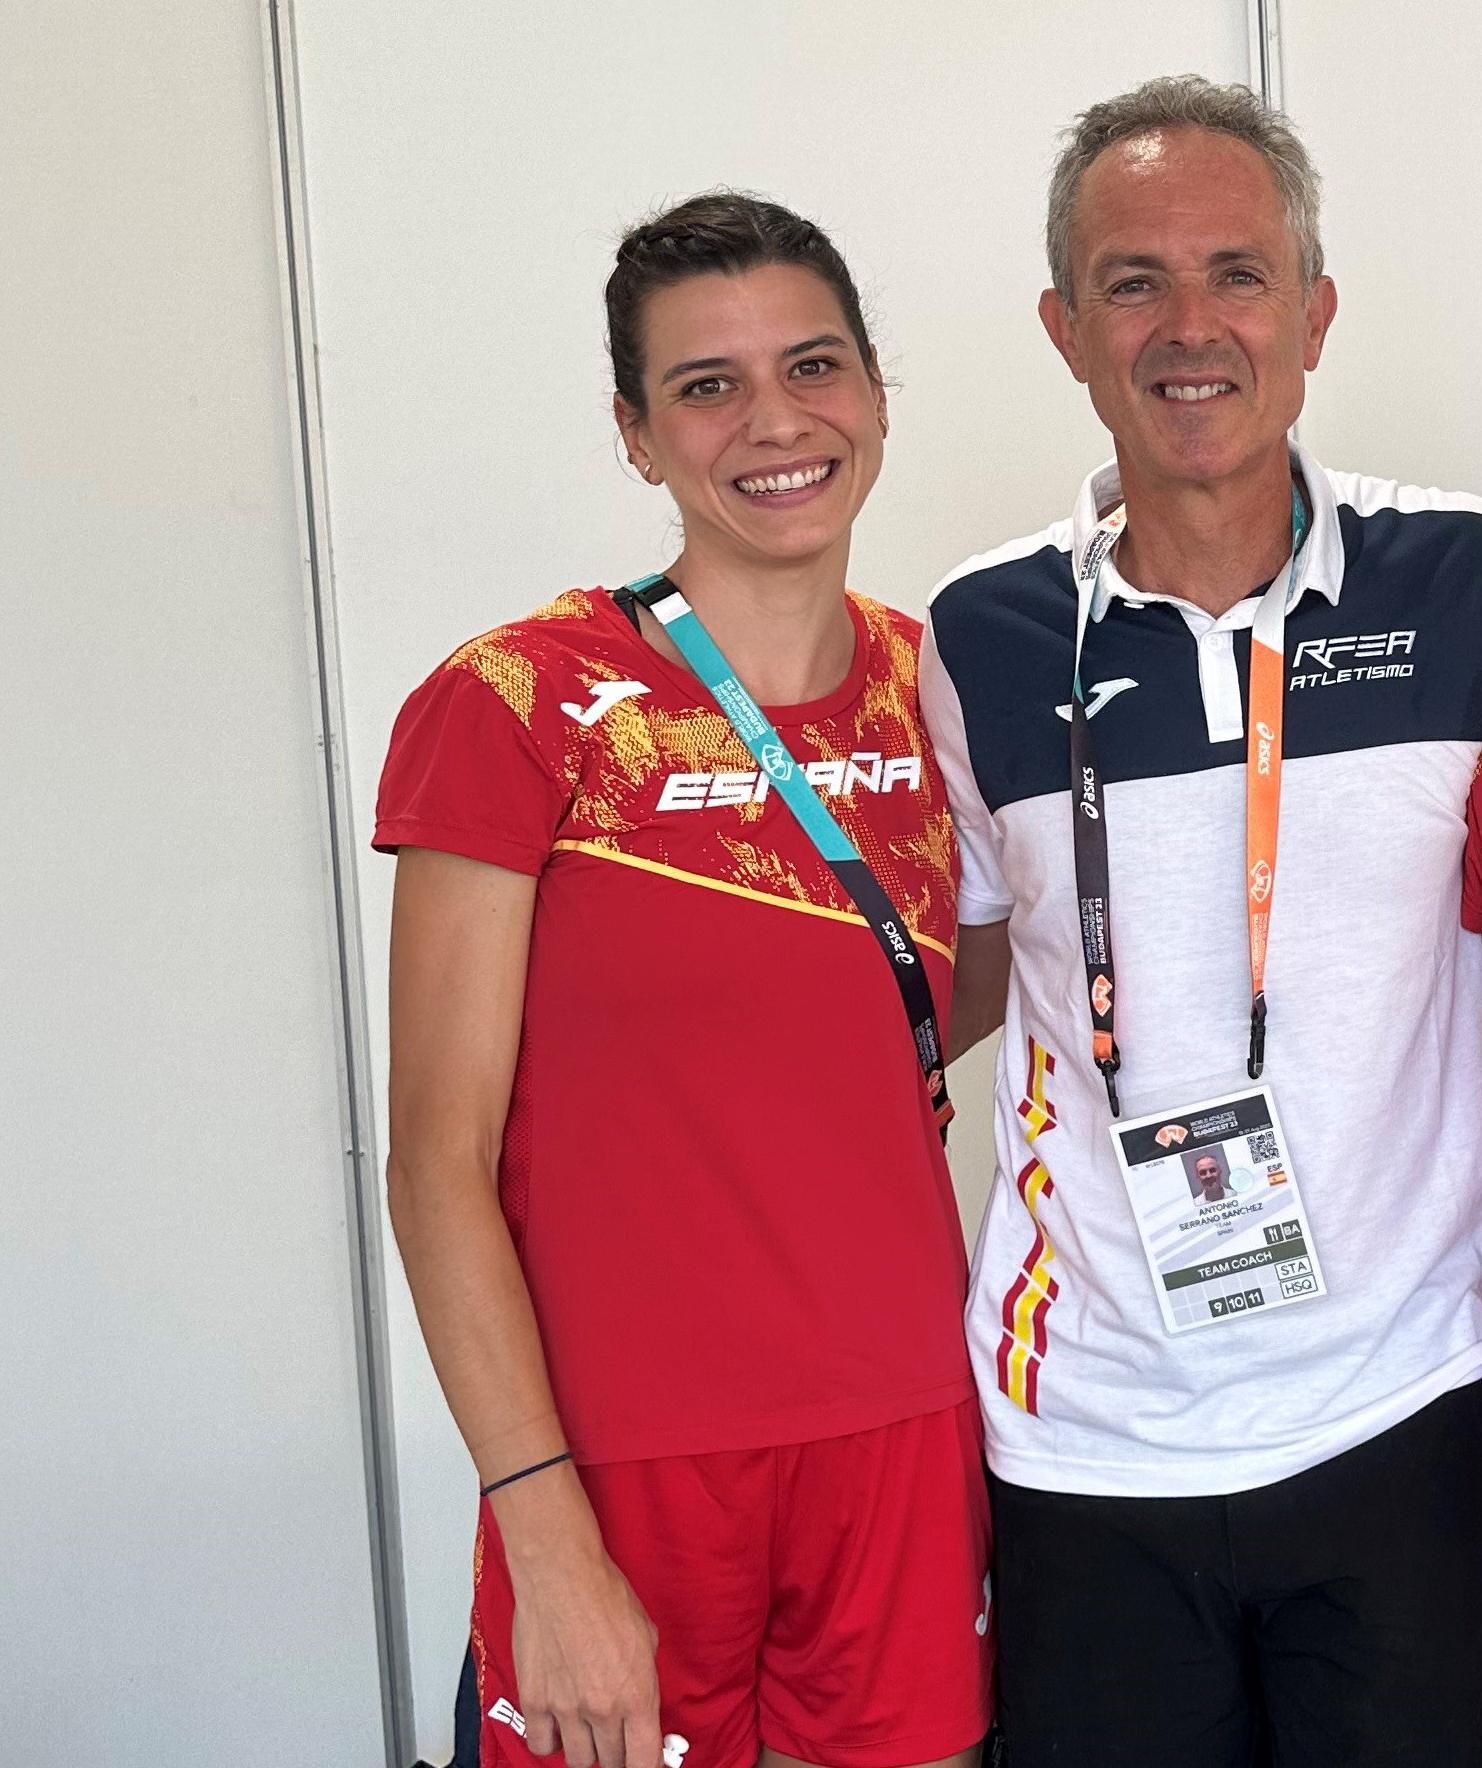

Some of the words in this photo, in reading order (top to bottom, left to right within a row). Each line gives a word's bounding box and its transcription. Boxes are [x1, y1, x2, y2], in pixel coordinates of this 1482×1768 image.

[1292, 630, 1417, 668] RFEA
[1289, 663, 1415, 691] ATLETISMO
[1257, 741, 1271, 776] asics
[1082, 766, 1096, 803] asics
[881, 920, 907, 952] asics
[1096, 910, 1107, 964] BUDAPEST
[1267, 1163, 1283, 1173] ESP
[1179, 1214, 1221, 1232] SERRANO
[1221, 1202, 1264, 1219] SANCHEZ
[1199, 1199, 1239, 1216] ANTONIO
[1198, 1263, 1231, 1279] TEAM
[1231, 1251, 1273, 1270] COACH
[1280, 1261, 1308, 1276] STA
[1285, 1279, 1313, 1294] HSQ
[1213, 1301, 1223, 1313] 9
[1229, 1296, 1244, 1310] 10
[1247, 1291, 1262, 1305] 11
